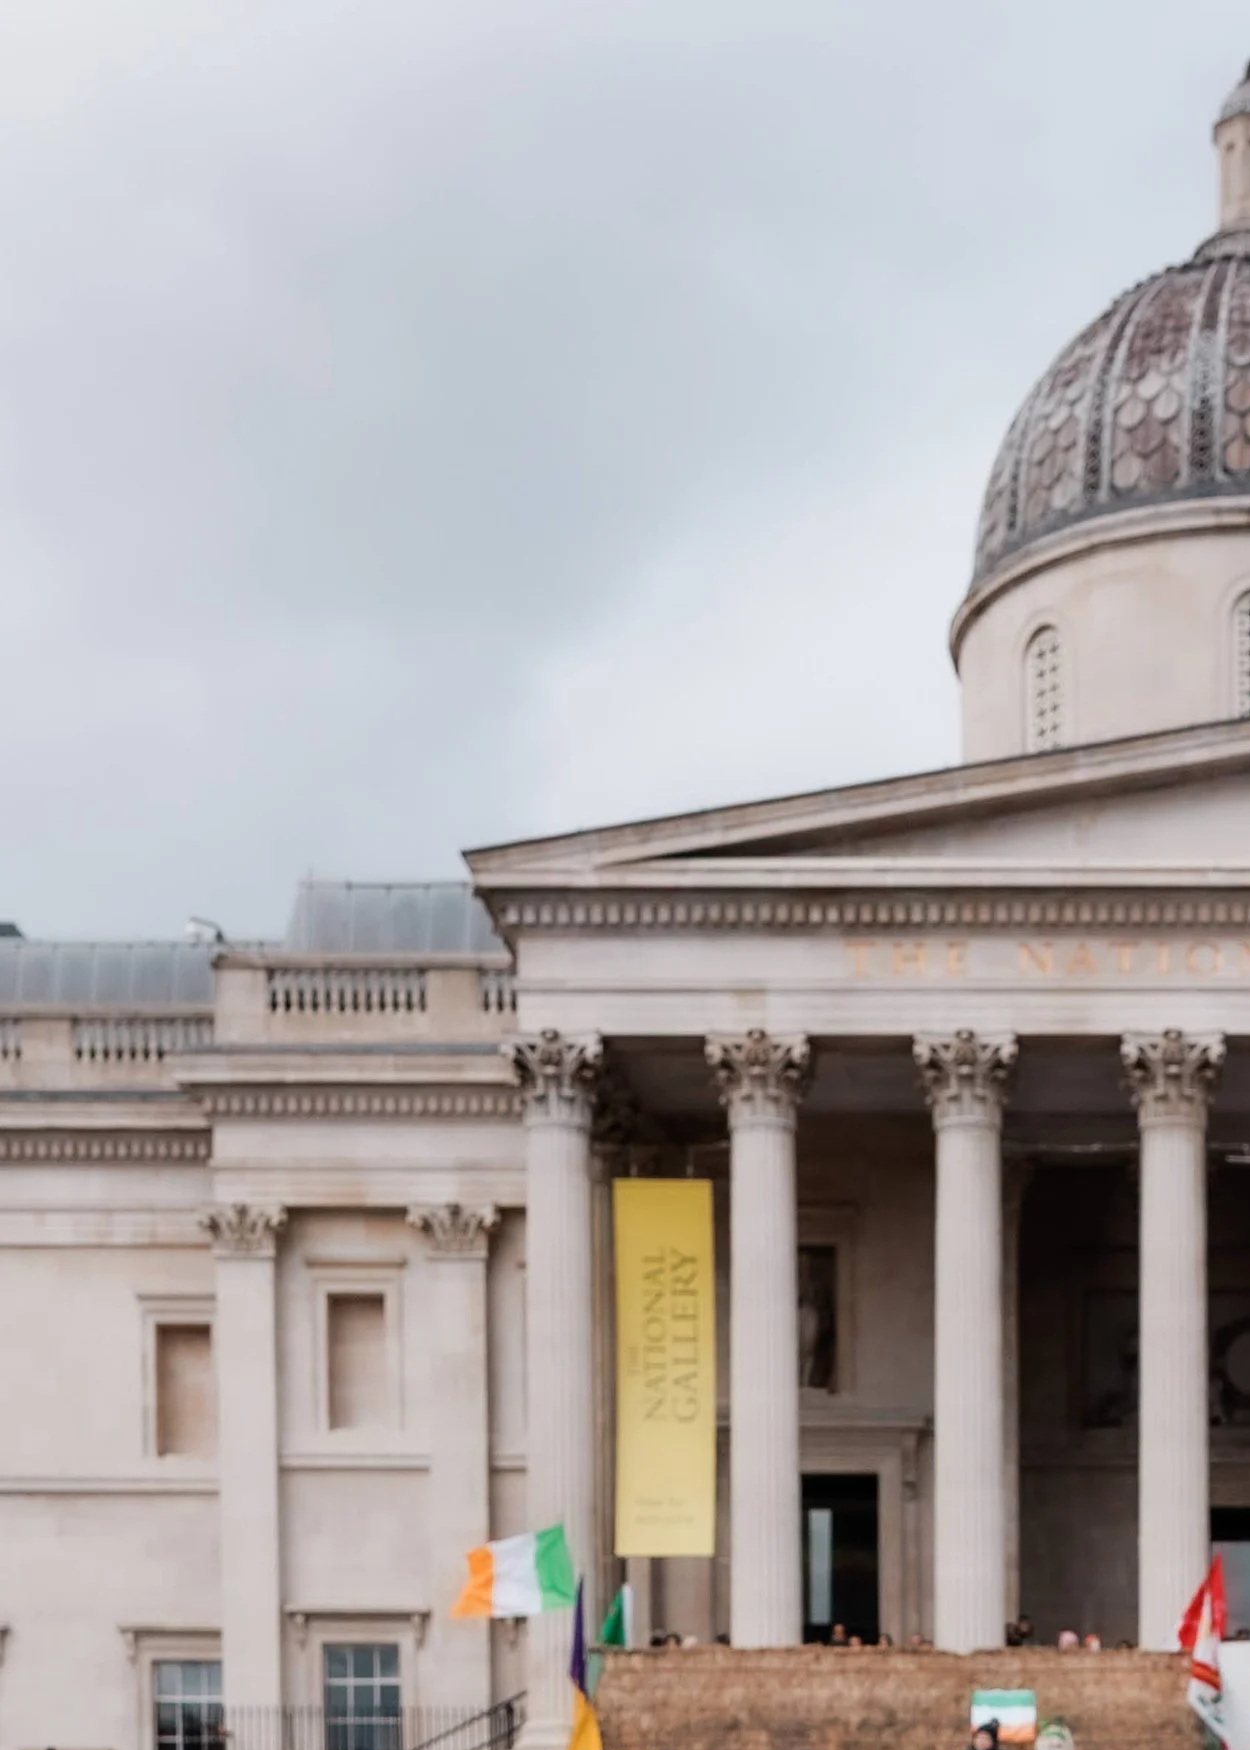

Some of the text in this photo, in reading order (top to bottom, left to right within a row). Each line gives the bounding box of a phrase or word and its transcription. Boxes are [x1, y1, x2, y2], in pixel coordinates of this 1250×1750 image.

[842, 938, 969, 977] THE
[640, 1244, 667, 1422] NATIONAL
[669, 1244, 700, 1425] GALLERY
